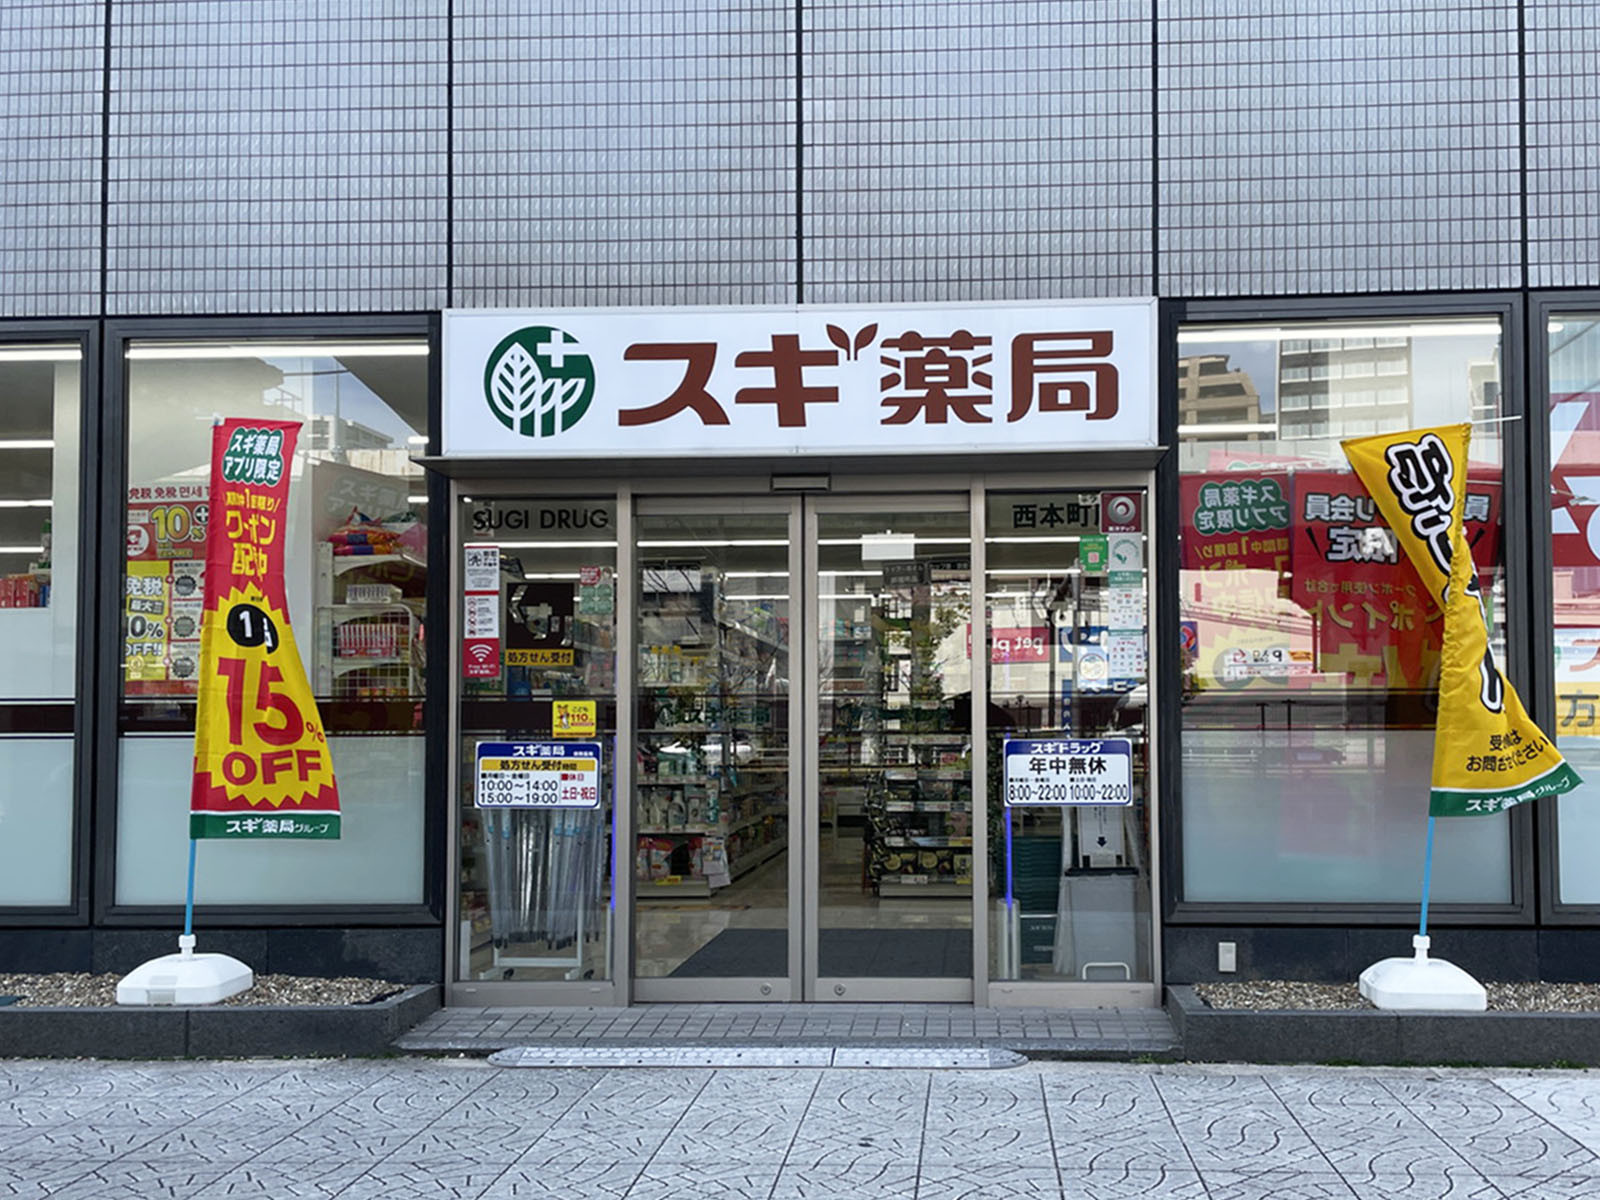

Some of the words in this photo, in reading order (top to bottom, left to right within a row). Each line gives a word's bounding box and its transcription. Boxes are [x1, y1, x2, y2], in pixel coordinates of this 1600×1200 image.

[618, 323, 1119, 428] スギ薬局
[230, 434, 280, 456] スギ薬局
[224, 456, 281, 480] アプリ限定
[473, 509, 529, 530] SUGI
[540, 509, 609, 529] DRUG
[1013, 503, 1100, 528] 西本町
[507, 650, 572, 664] 処方せん受付
[512, 744, 566, 757] スギ薬局
[1030, 741, 1104, 754] スギドラッグ
[222, 749, 322, 786] OFF
[1029, 757, 1107, 775] 年中無休
[226, 817, 329, 834] スギ薬局グループ
